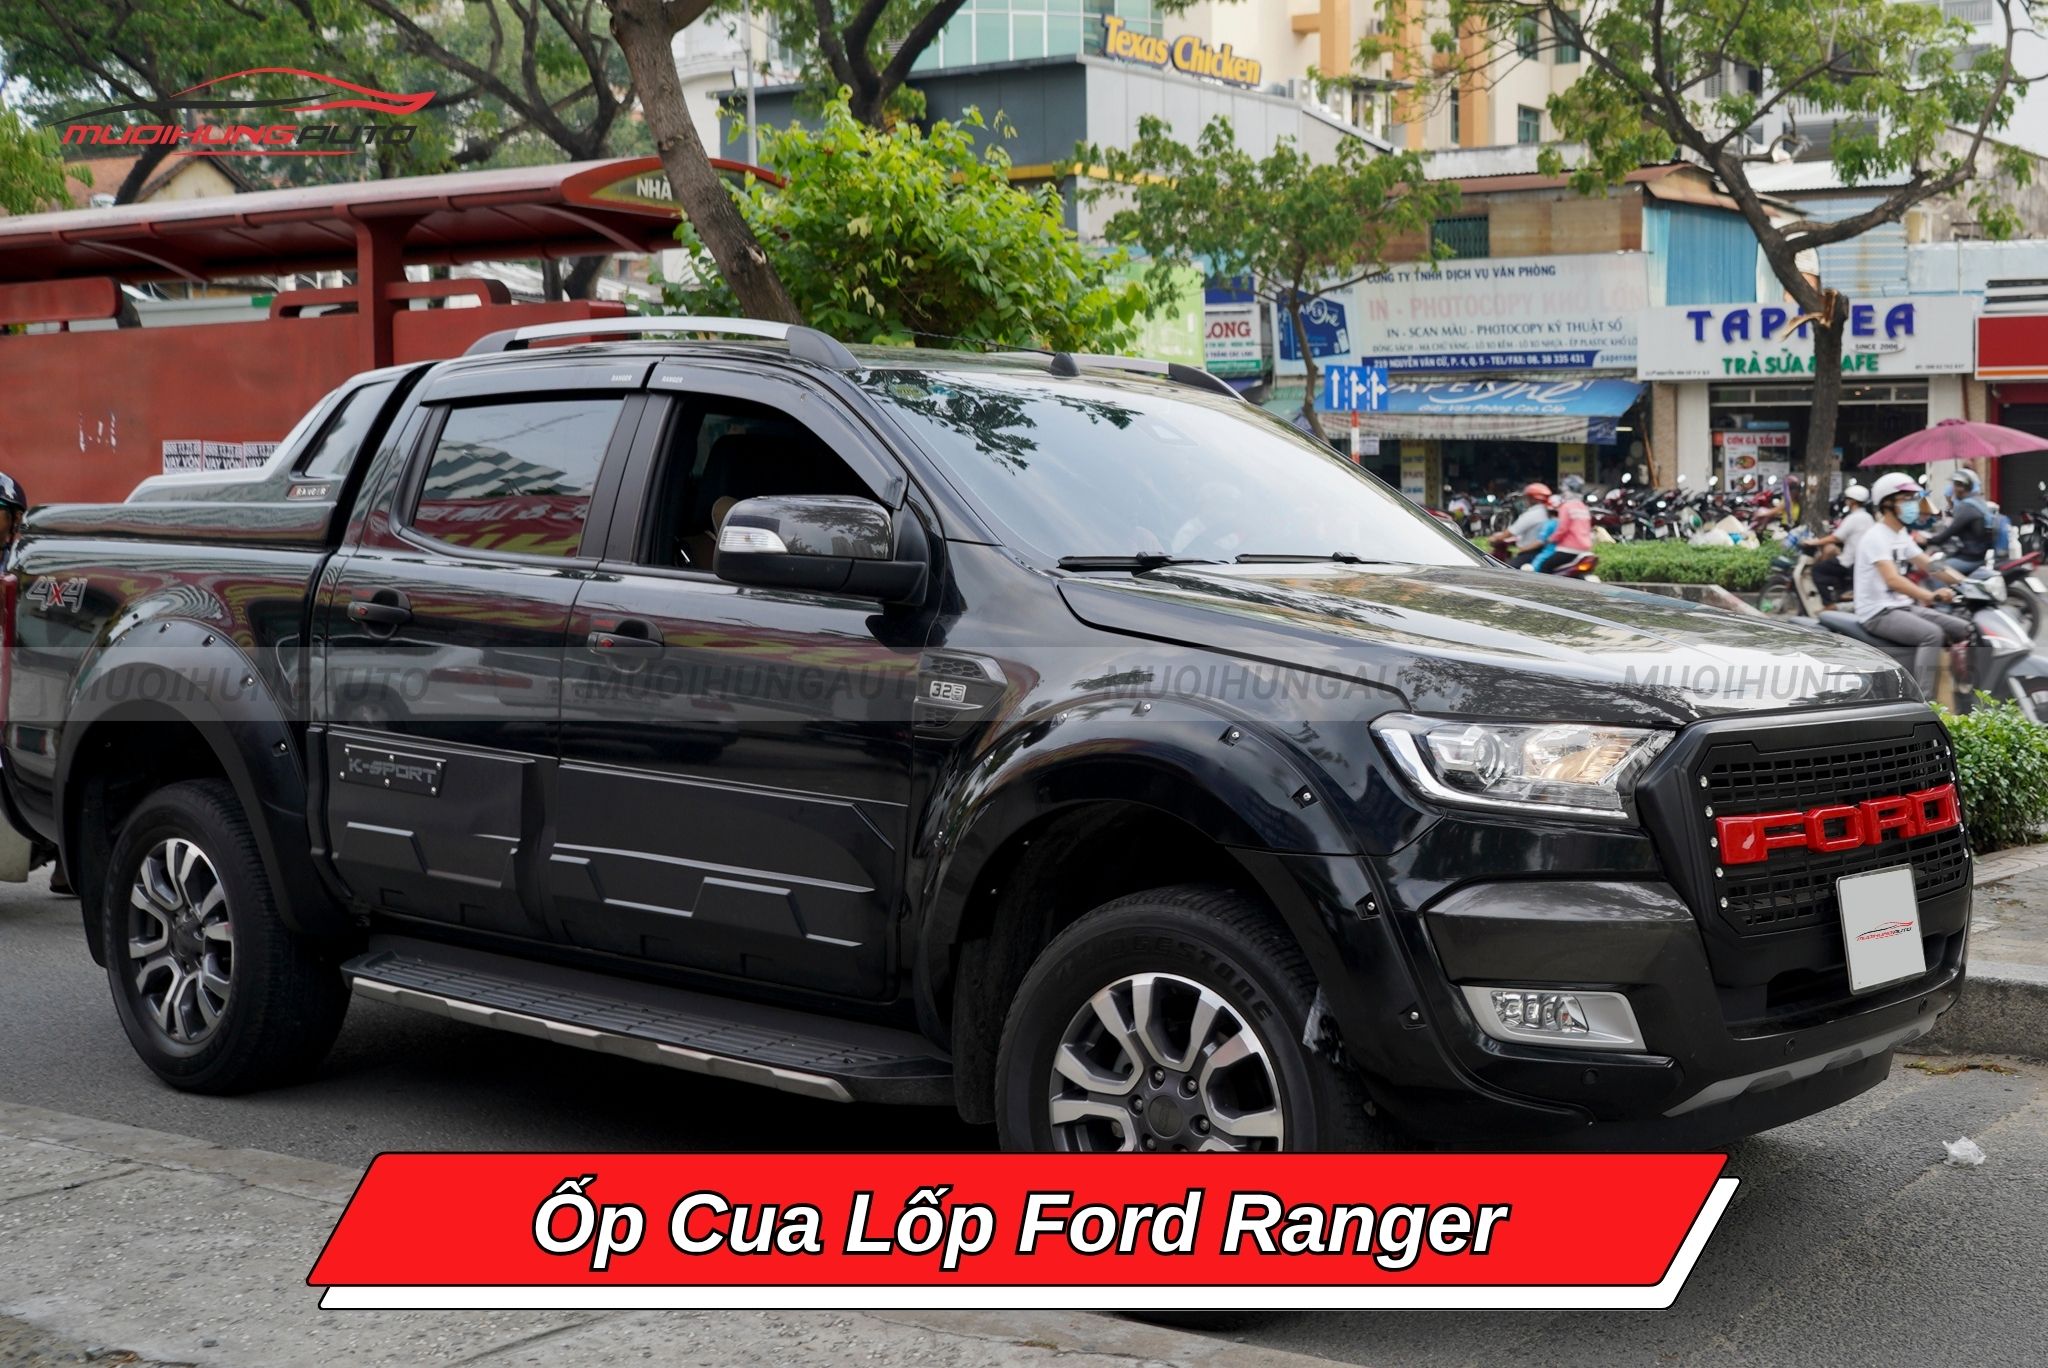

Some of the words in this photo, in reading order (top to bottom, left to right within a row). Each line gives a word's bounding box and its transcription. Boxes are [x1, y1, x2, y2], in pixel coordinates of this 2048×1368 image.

[1104, 14, 1168, 66] Texas
[1173, 35, 1261, 86] Chicken
[637, 175, 672, 201] NHÀ
[1398, 272, 1411, 283] TY
[1446, 268, 1471, 282] DỊCH
[1475, 268, 1489, 281] VỤ
[1493, 265, 1515, 278] VĂN
[1518, 264, 1556, 277] PHÒNG
[1410, 292, 1535, 320] PHOTOCOPY
[1387, 328, 1399, 338] IN
[1409, 326, 1438, 338] SCAN
[1442, 322, 1467, 337] MÀU
[1477, 322, 1542, 336] PHOTOCOPY
[1566, 318, 1605, 335] THUẬT
[1608, 315, 1623, 332] SỐ
[1687, 302, 1915, 345] TAPIEA
[1722, 350, 1761, 375] TRÀ
[1765, 348, 1804, 375] SỮA
[1842, 353, 1880, 373] AFE
[349, 758, 437, 784] K-SPORT
[1716, 783, 1962, 865] FORD
